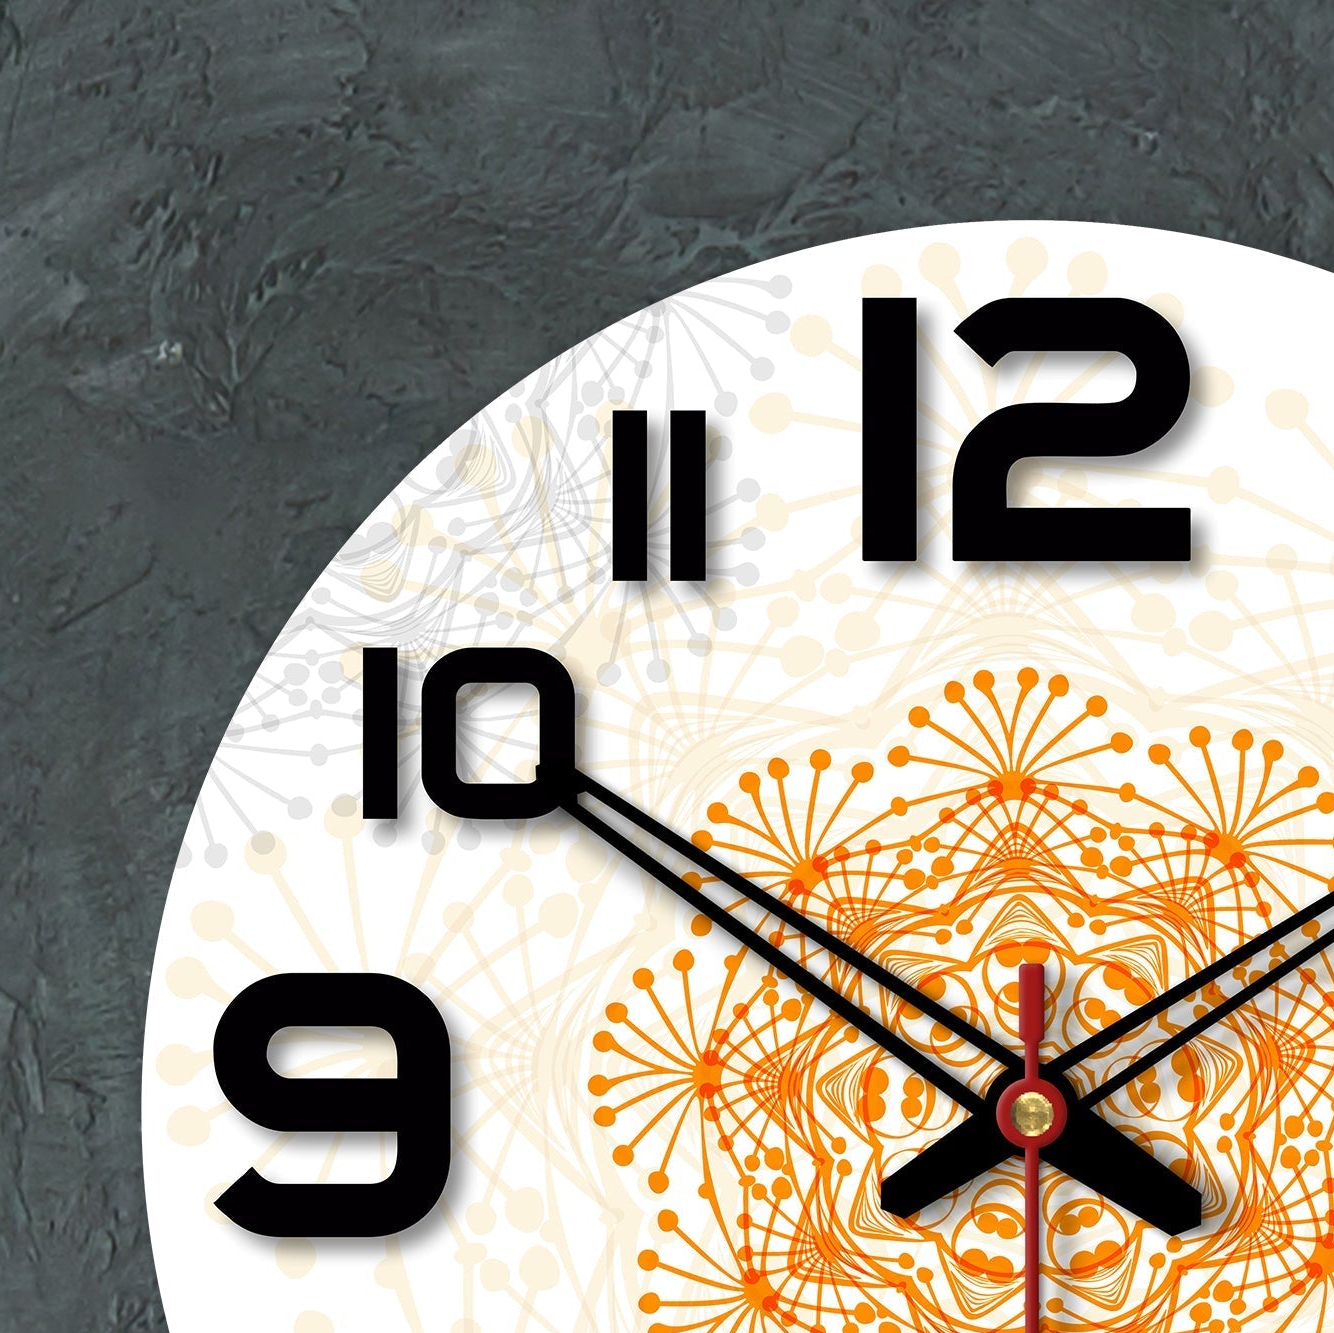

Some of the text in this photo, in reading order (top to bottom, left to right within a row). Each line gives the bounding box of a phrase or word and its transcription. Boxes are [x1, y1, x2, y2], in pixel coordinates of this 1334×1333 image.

[613, 410, 707, 582] 11
[863, 298, 1191, 562] 12
[363, 647, 575, 820] 10
[214, 973, 451, 1238] 9
